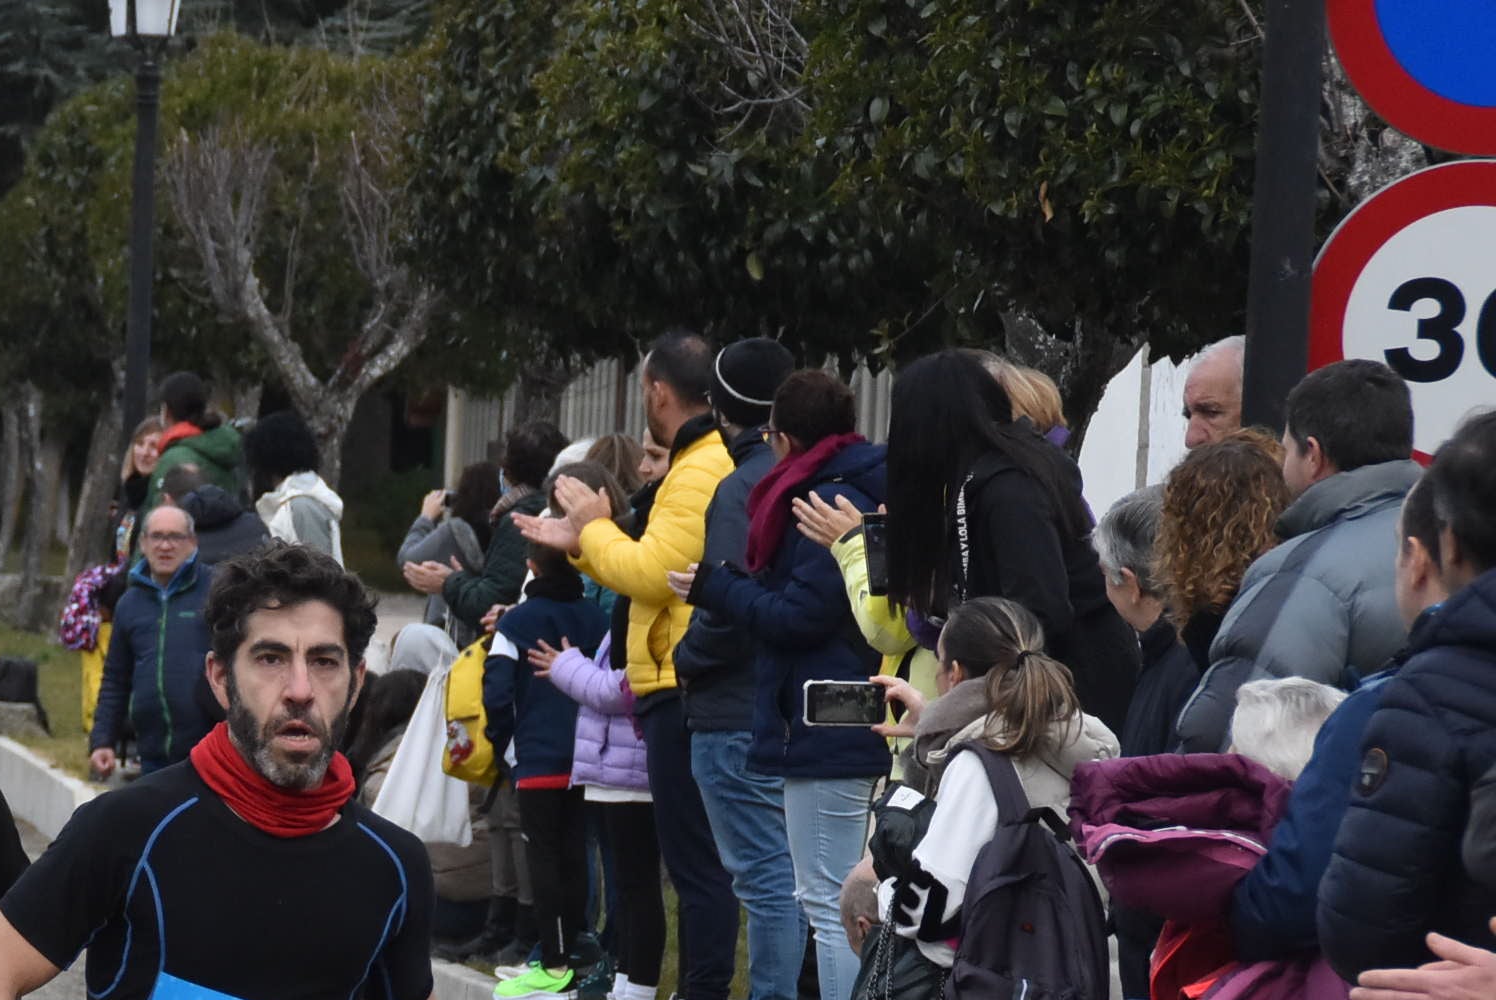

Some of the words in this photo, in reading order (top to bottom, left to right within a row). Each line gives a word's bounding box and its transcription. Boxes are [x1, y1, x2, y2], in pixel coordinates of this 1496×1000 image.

[1384, 277, 1496, 383] 3
[957, 486, 966, 515] BIM
[958, 517, 968, 541] LOLA
